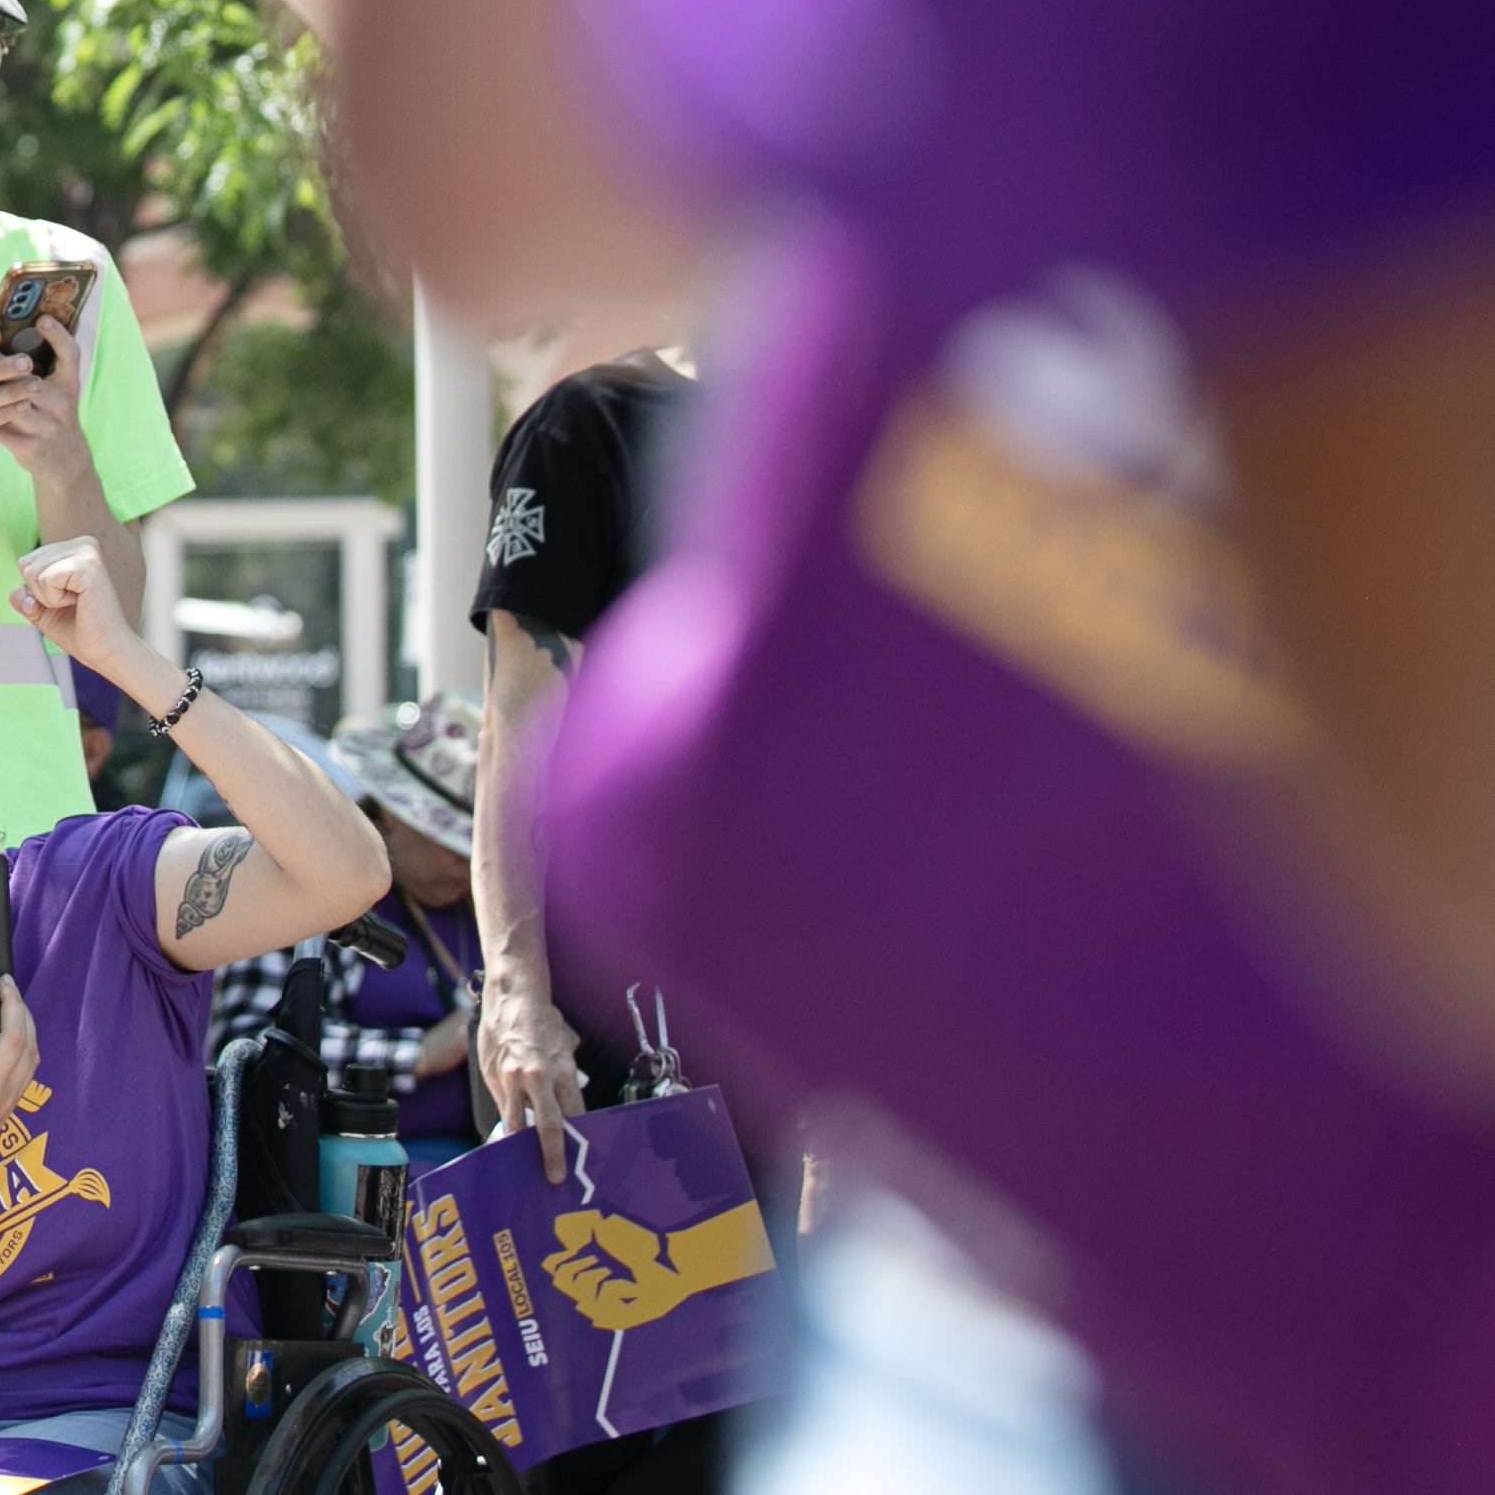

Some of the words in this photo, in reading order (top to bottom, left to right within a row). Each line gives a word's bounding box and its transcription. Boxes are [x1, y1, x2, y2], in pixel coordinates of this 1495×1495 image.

[496, 1232, 517, 1268] 105
[504, 1267, 532, 1314] LOCAL
[412, 1193, 524, 1447] JANITORS
[413, 1305, 437, 1345] LOS
[521, 1318, 549, 1367] SEIU
